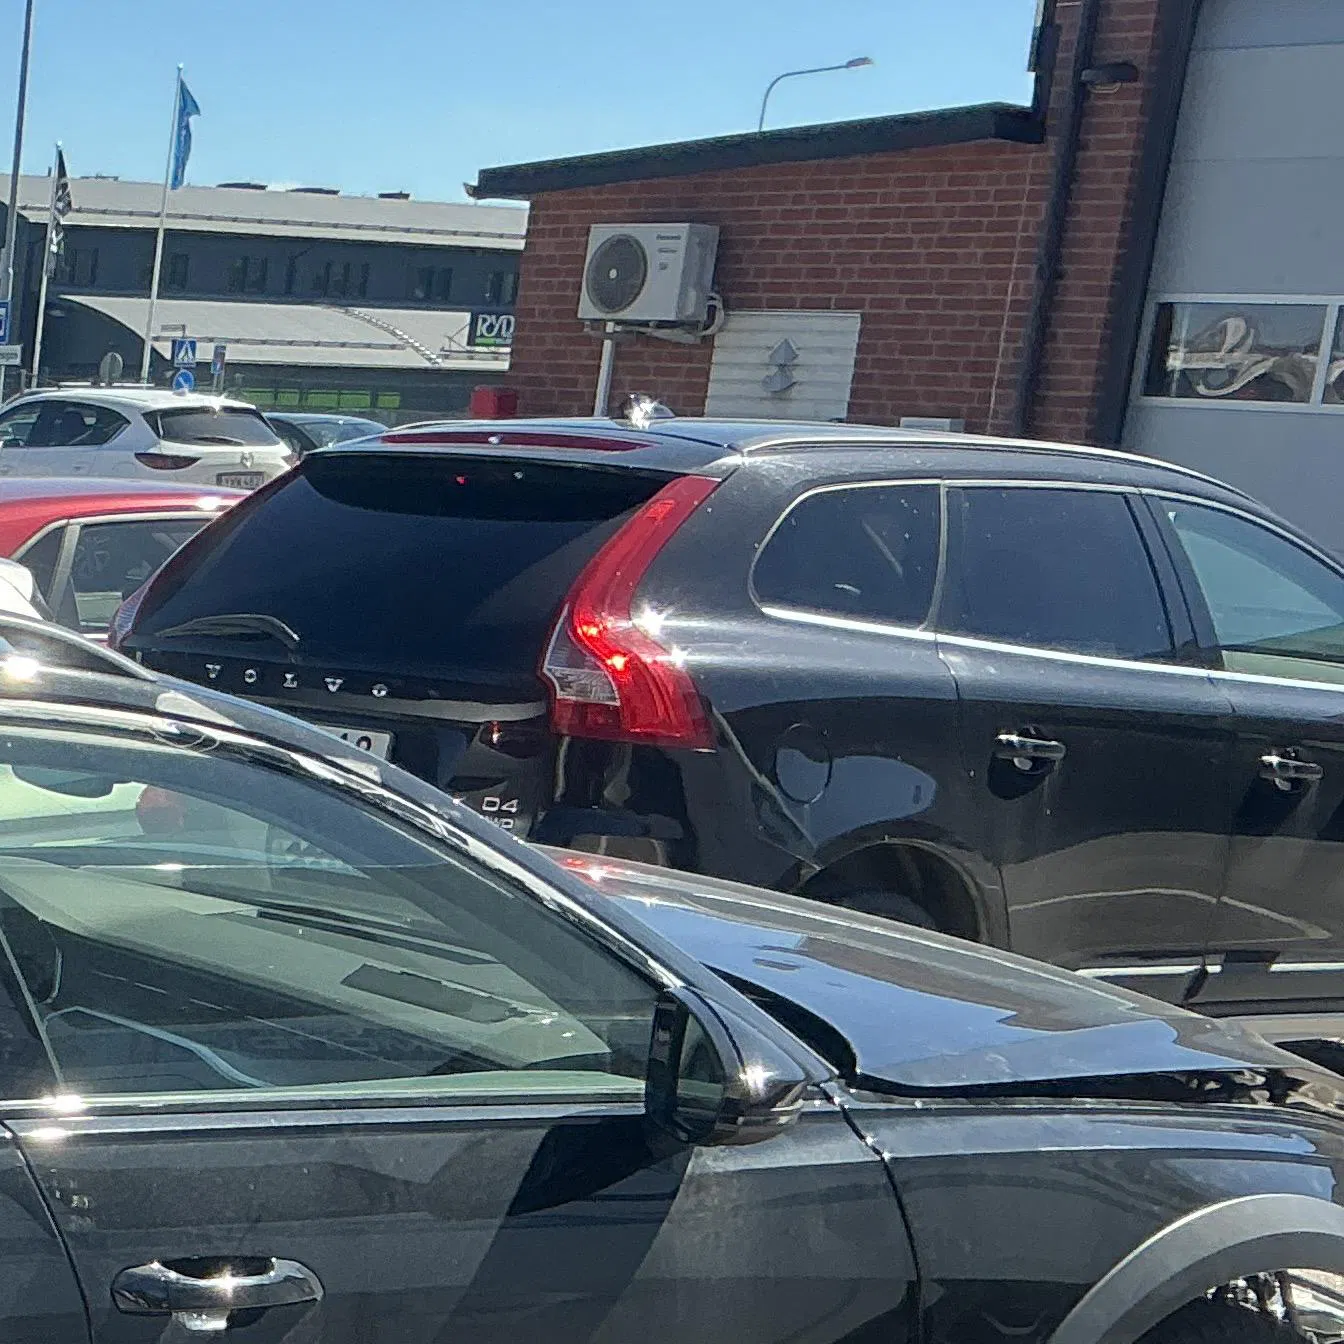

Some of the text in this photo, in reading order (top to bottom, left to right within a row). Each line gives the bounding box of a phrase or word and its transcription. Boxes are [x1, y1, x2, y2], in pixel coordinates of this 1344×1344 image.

[476, 314, 516, 337] RYD
[206, 663, 388, 697] VOLVO
[482, 797, 519, 813] D4
